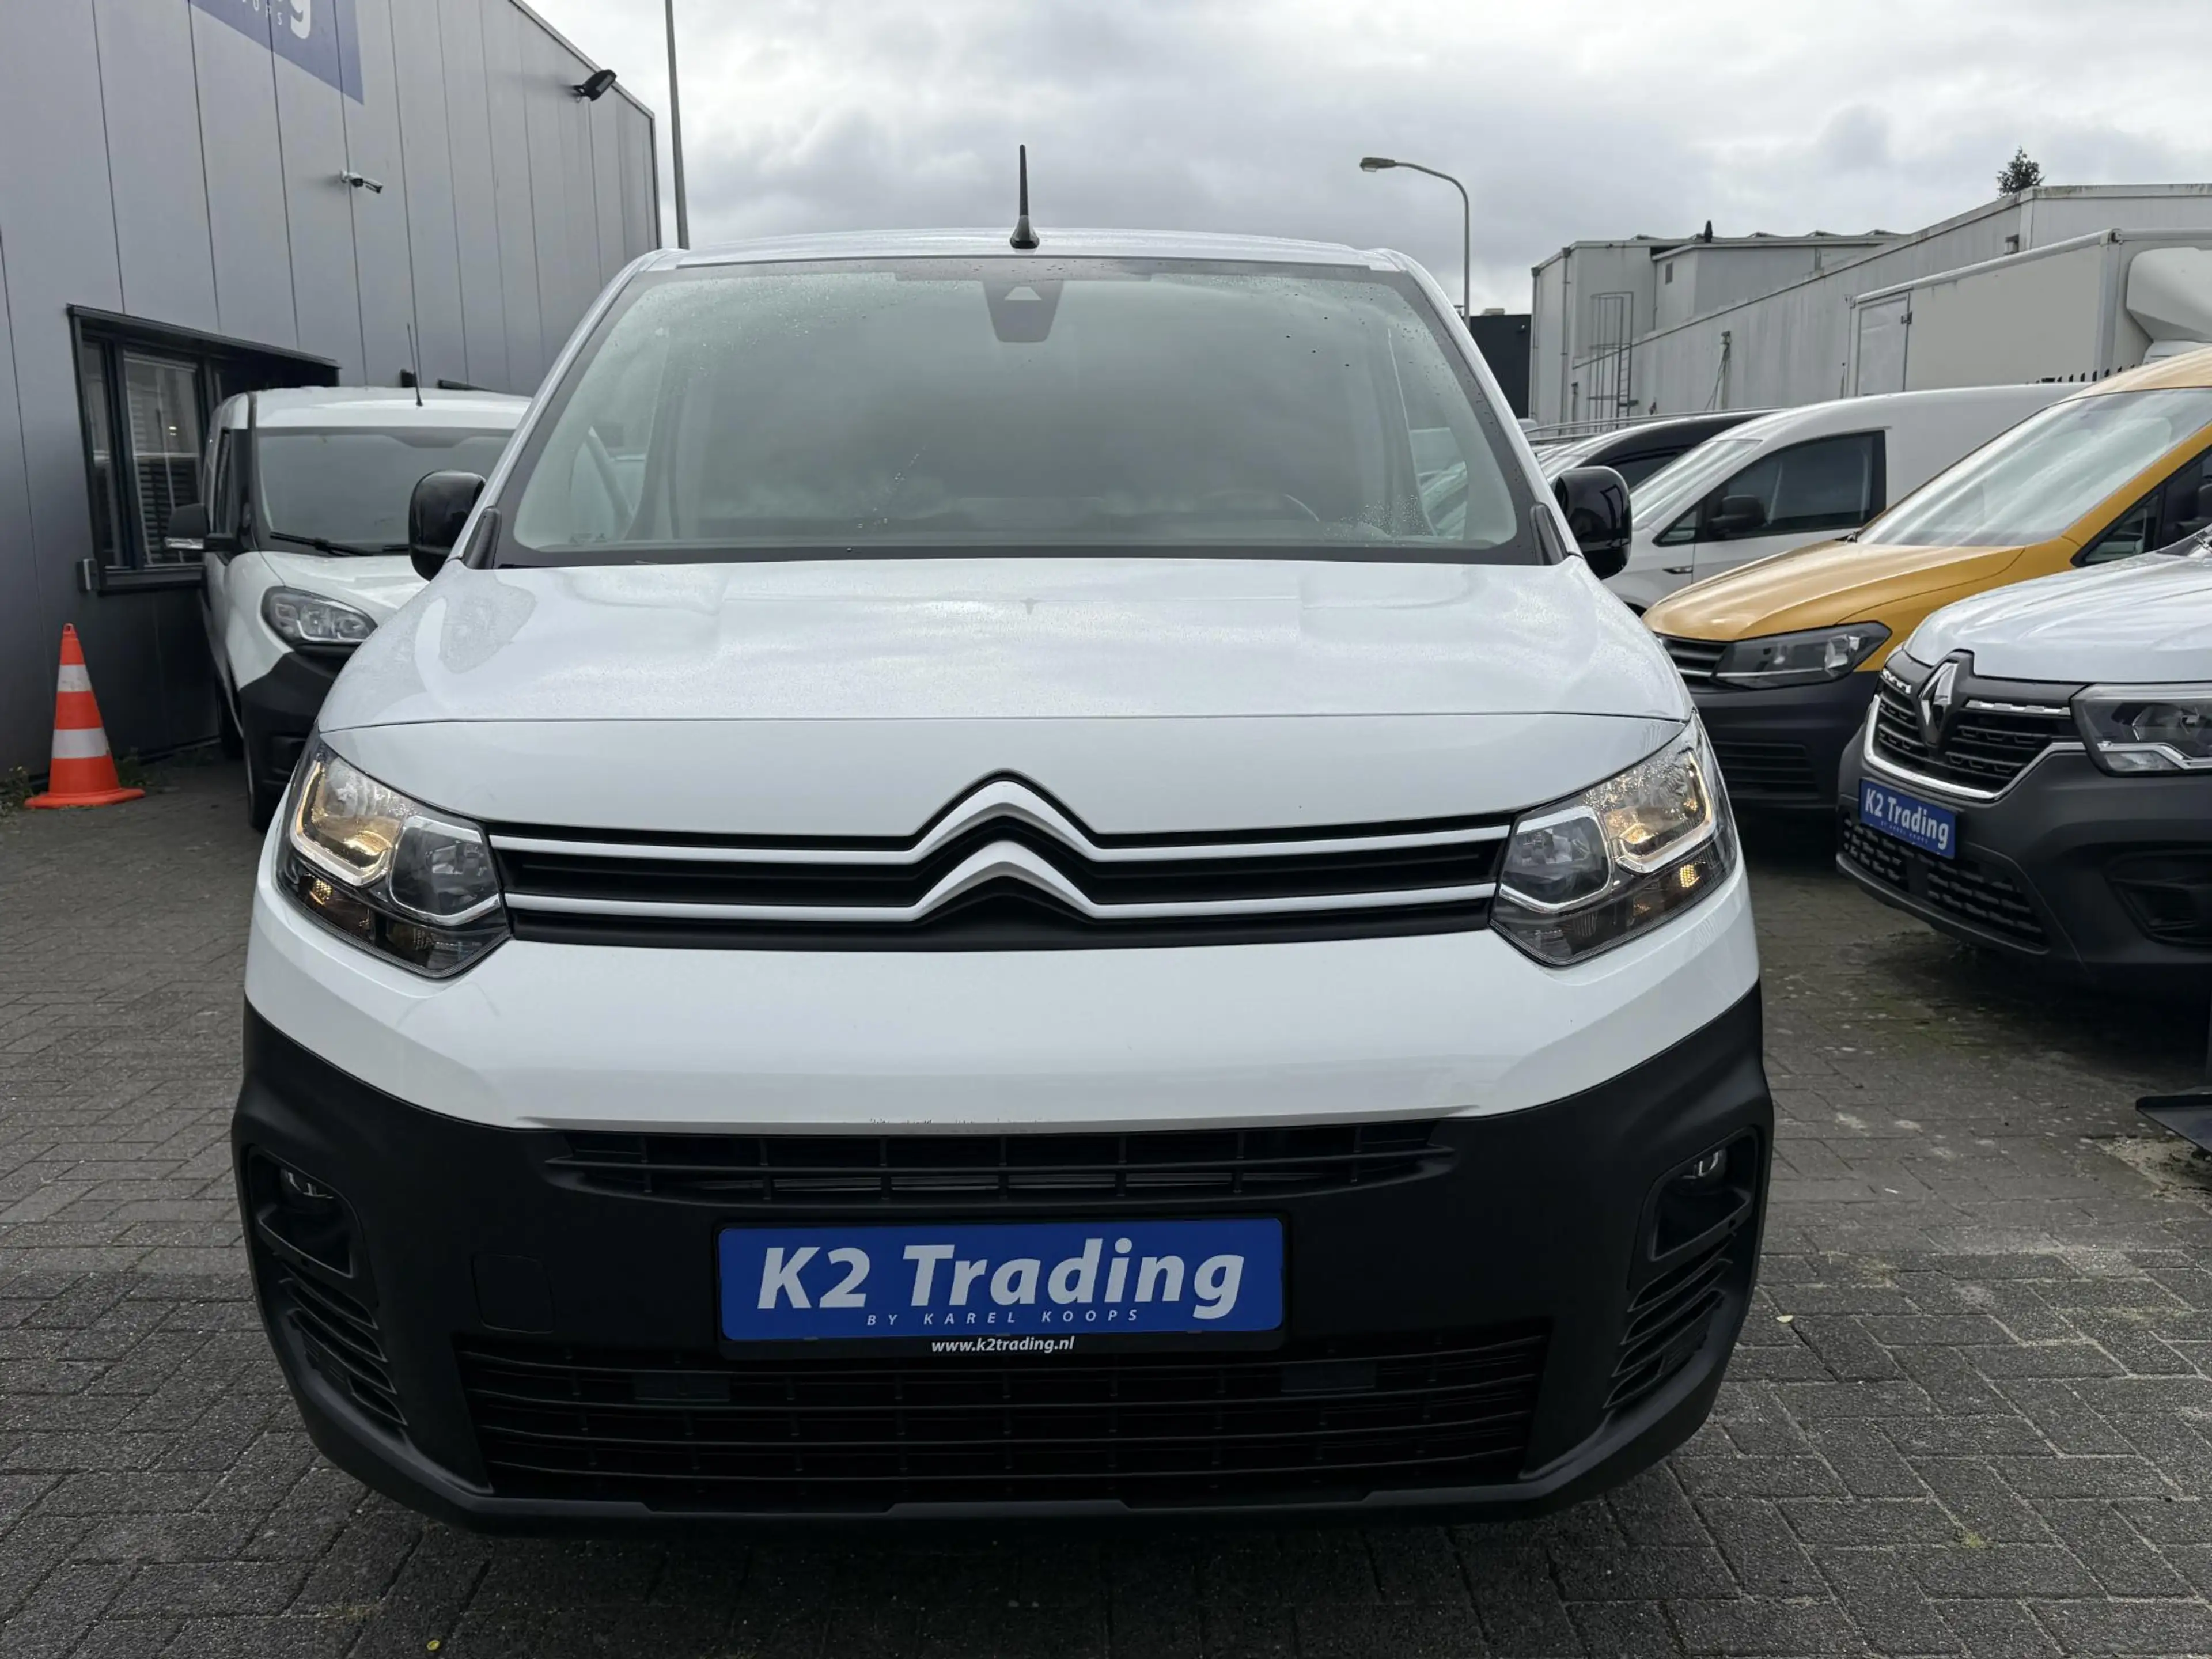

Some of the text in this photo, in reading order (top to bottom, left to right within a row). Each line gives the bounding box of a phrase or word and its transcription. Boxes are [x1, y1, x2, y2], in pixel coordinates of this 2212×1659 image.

[1865, 787, 1884, 817] K2
[1887, 796, 1949, 850] Trading
[757, 1237, 1244, 1319] K2 Trading
[867, 1309, 1137, 1325] BY KAREL KOOPS
[931, 1335, 1075, 1354] www.k2trading.nl
